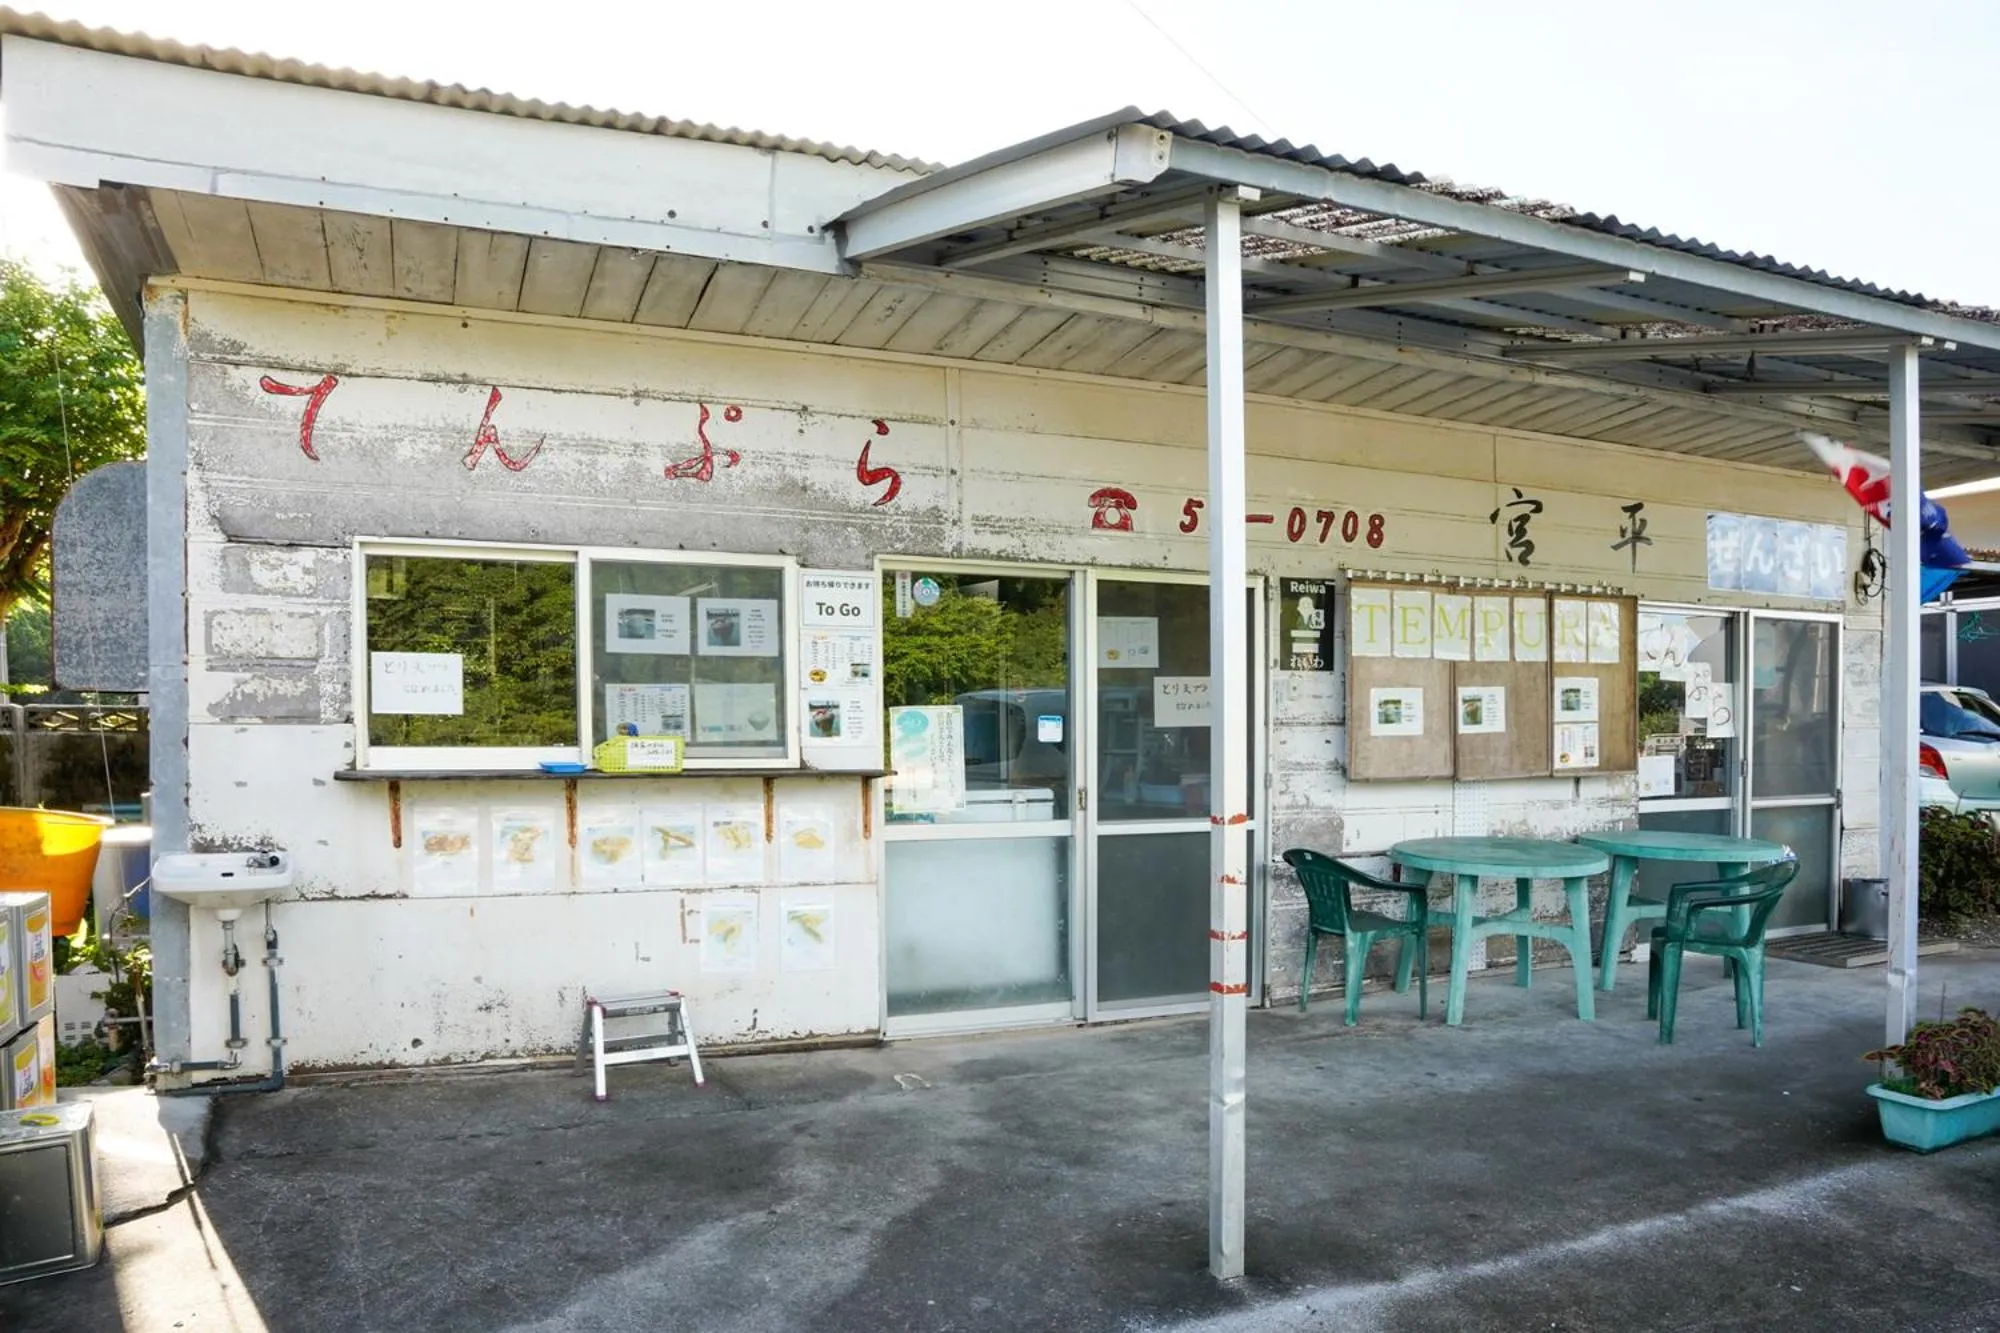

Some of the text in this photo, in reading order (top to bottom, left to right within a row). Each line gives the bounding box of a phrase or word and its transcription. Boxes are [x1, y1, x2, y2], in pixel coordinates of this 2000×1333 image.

[259, 373, 903, 508] てんぷら
[1179, 498, 1386, 549] 5-0708
[1489, 488, 1653, 573] 宮平
[1713, 527, 1844, 580] ぜんざい
[805, 580, 870, 590] お持ち帰りできます
[1290, 581, 1327, 595] Reiwa
[815, 602, 861, 617] To Go
[1356, 603, 1612, 649] TEMPURA
